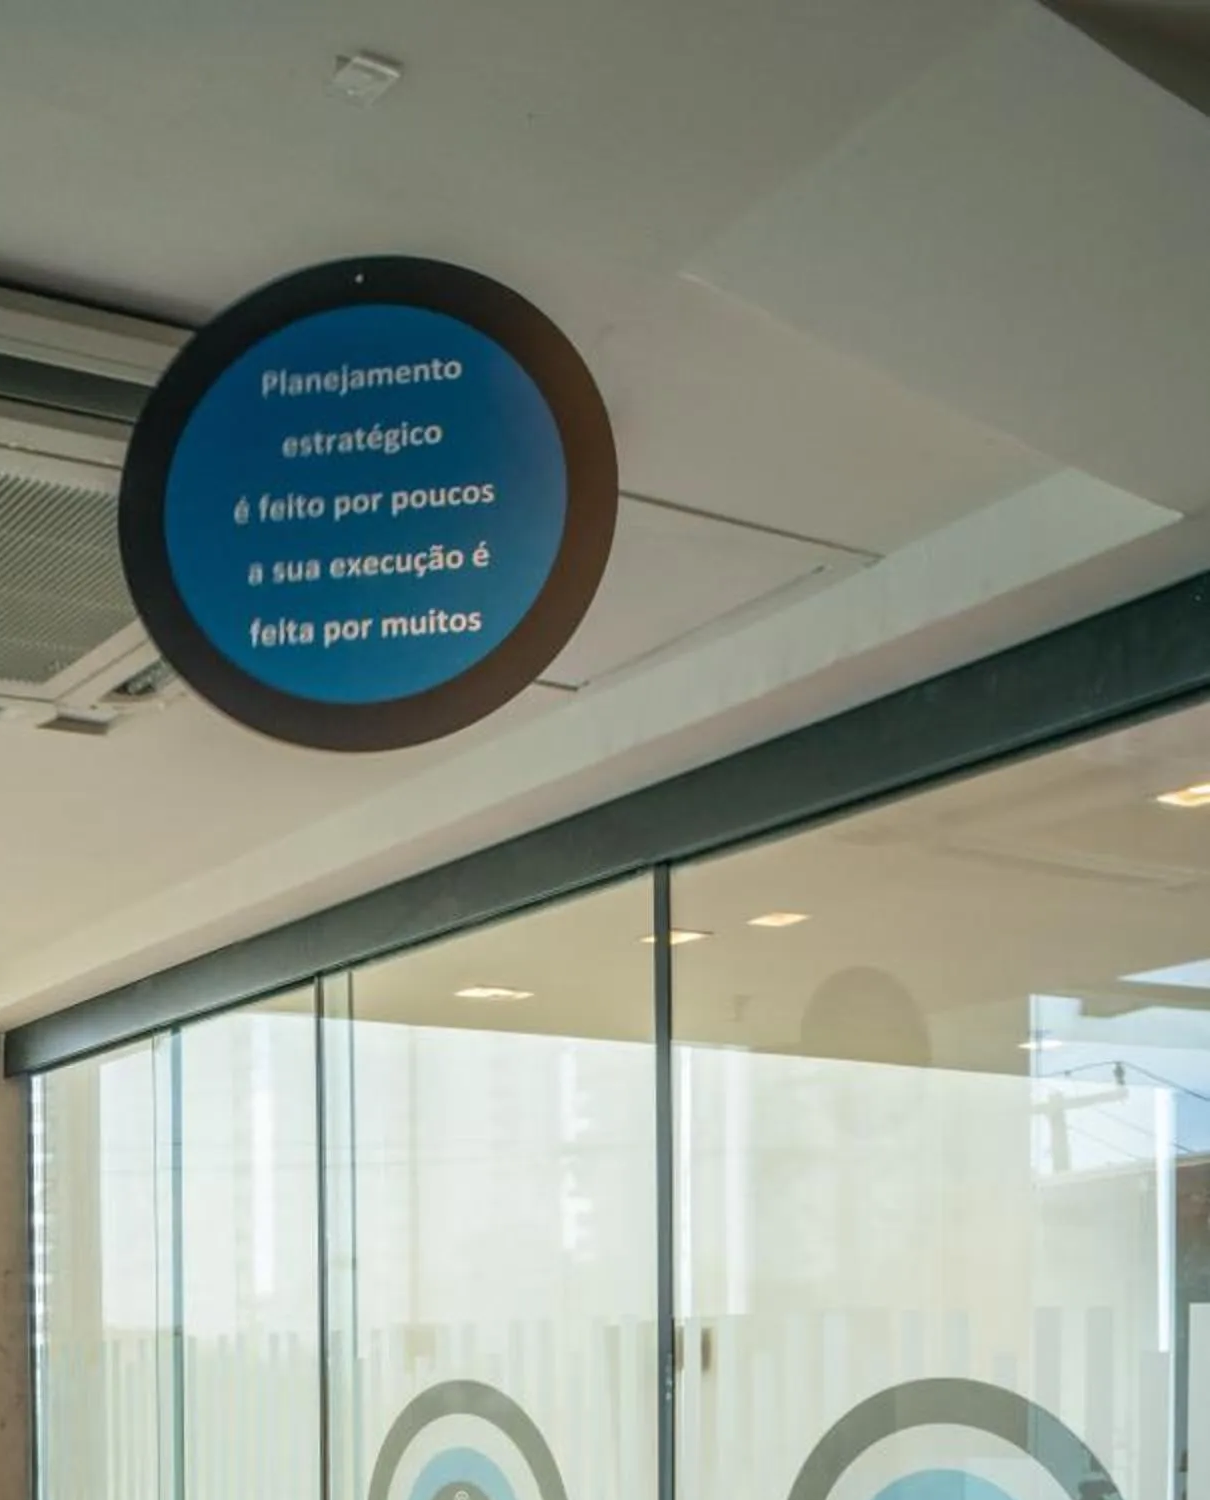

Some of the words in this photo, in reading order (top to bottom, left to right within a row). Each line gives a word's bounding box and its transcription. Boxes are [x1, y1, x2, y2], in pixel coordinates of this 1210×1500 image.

[261, 356, 463, 399] Planejamento
[282, 421, 443, 459] estratégico
[234, 497, 249, 525] é
[259, 494, 325, 523] feito
[334, 494, 382, 522] por
[391, 482, 495, 517] poucos
[248, 564, 264, 585] a
[273, 560, 320, 583] sua
[330, 545, 463, 579] execução
[472, 542, 490, 567] é
[250, 616, 314, 648] feita
[323, 617, 371, 648] por
[381, 608, 482, 637] muitos
